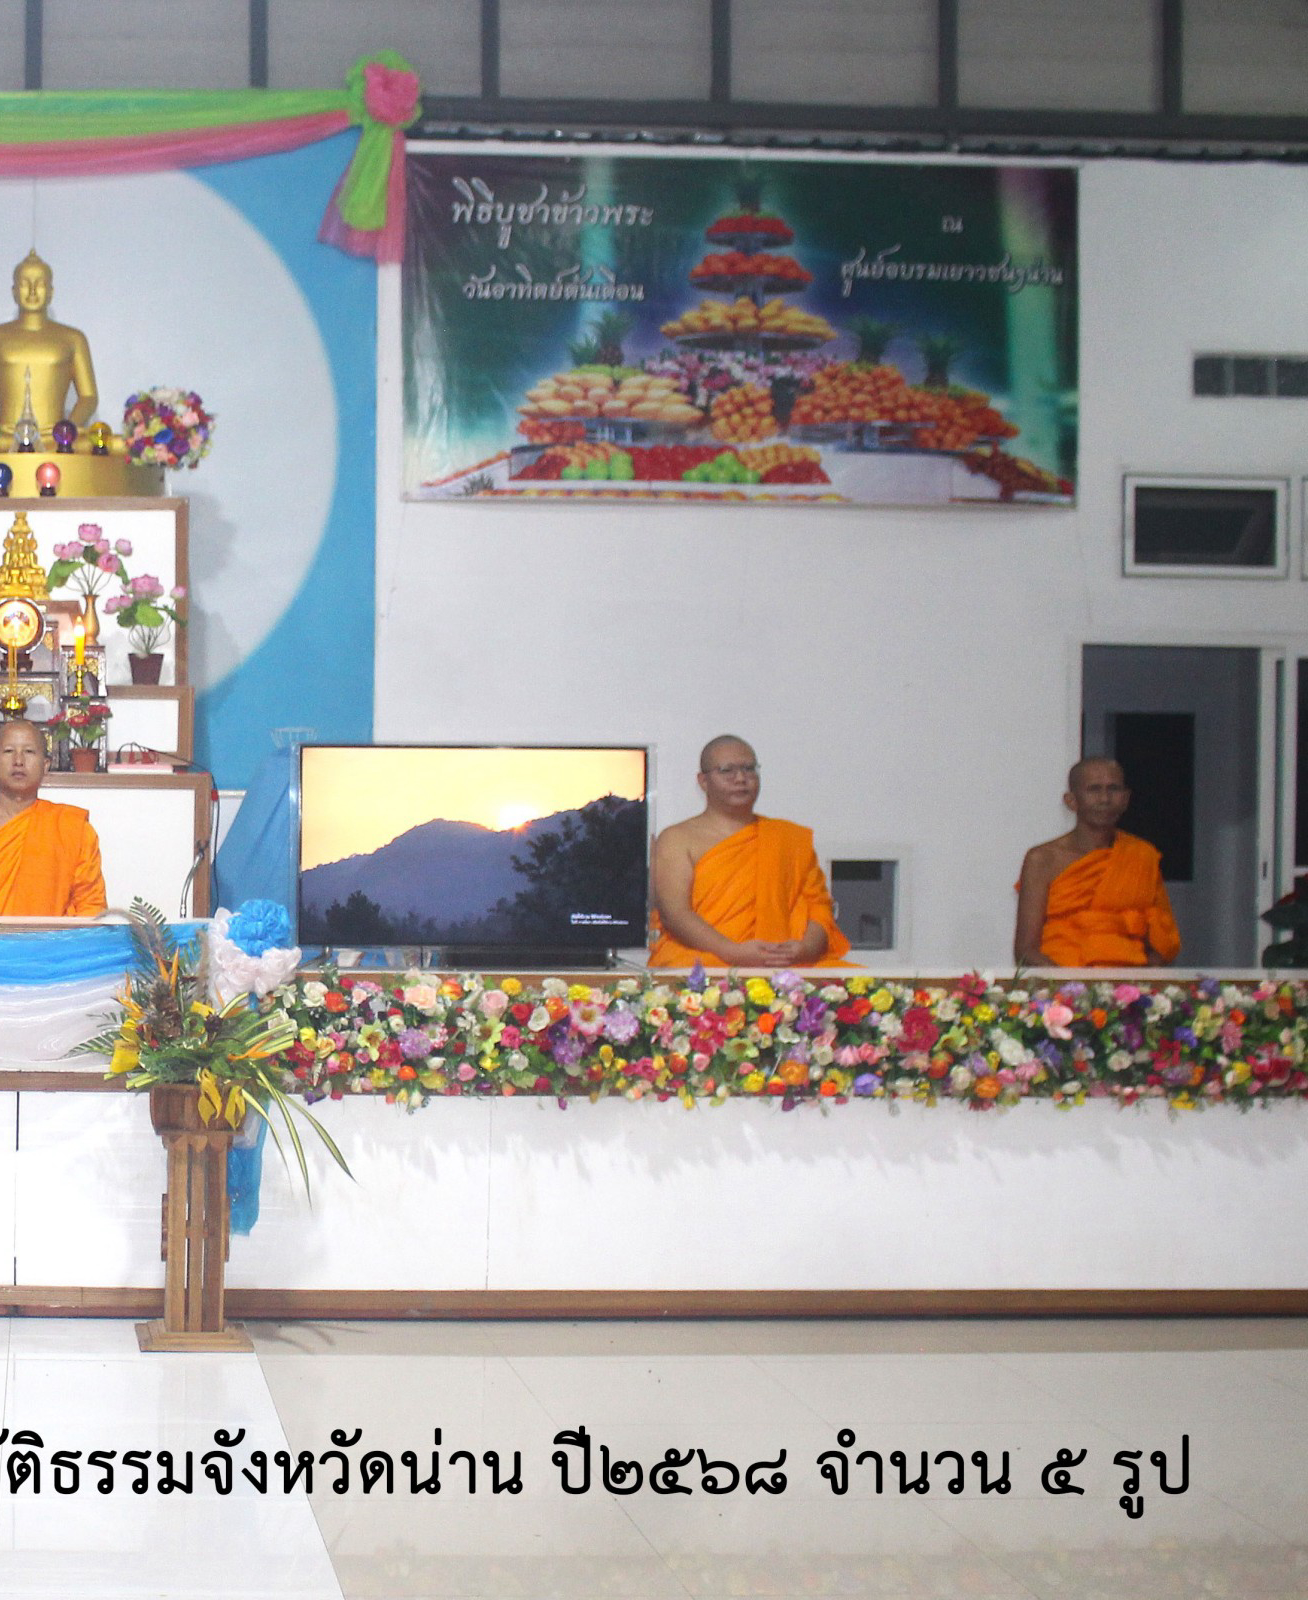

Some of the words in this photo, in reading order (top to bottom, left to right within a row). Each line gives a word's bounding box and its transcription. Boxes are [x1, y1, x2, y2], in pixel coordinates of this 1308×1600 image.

[942, 215, 963, 233] ณ
[462, 264, 644, 301] วันอาทิตย์ต้นเดือน
